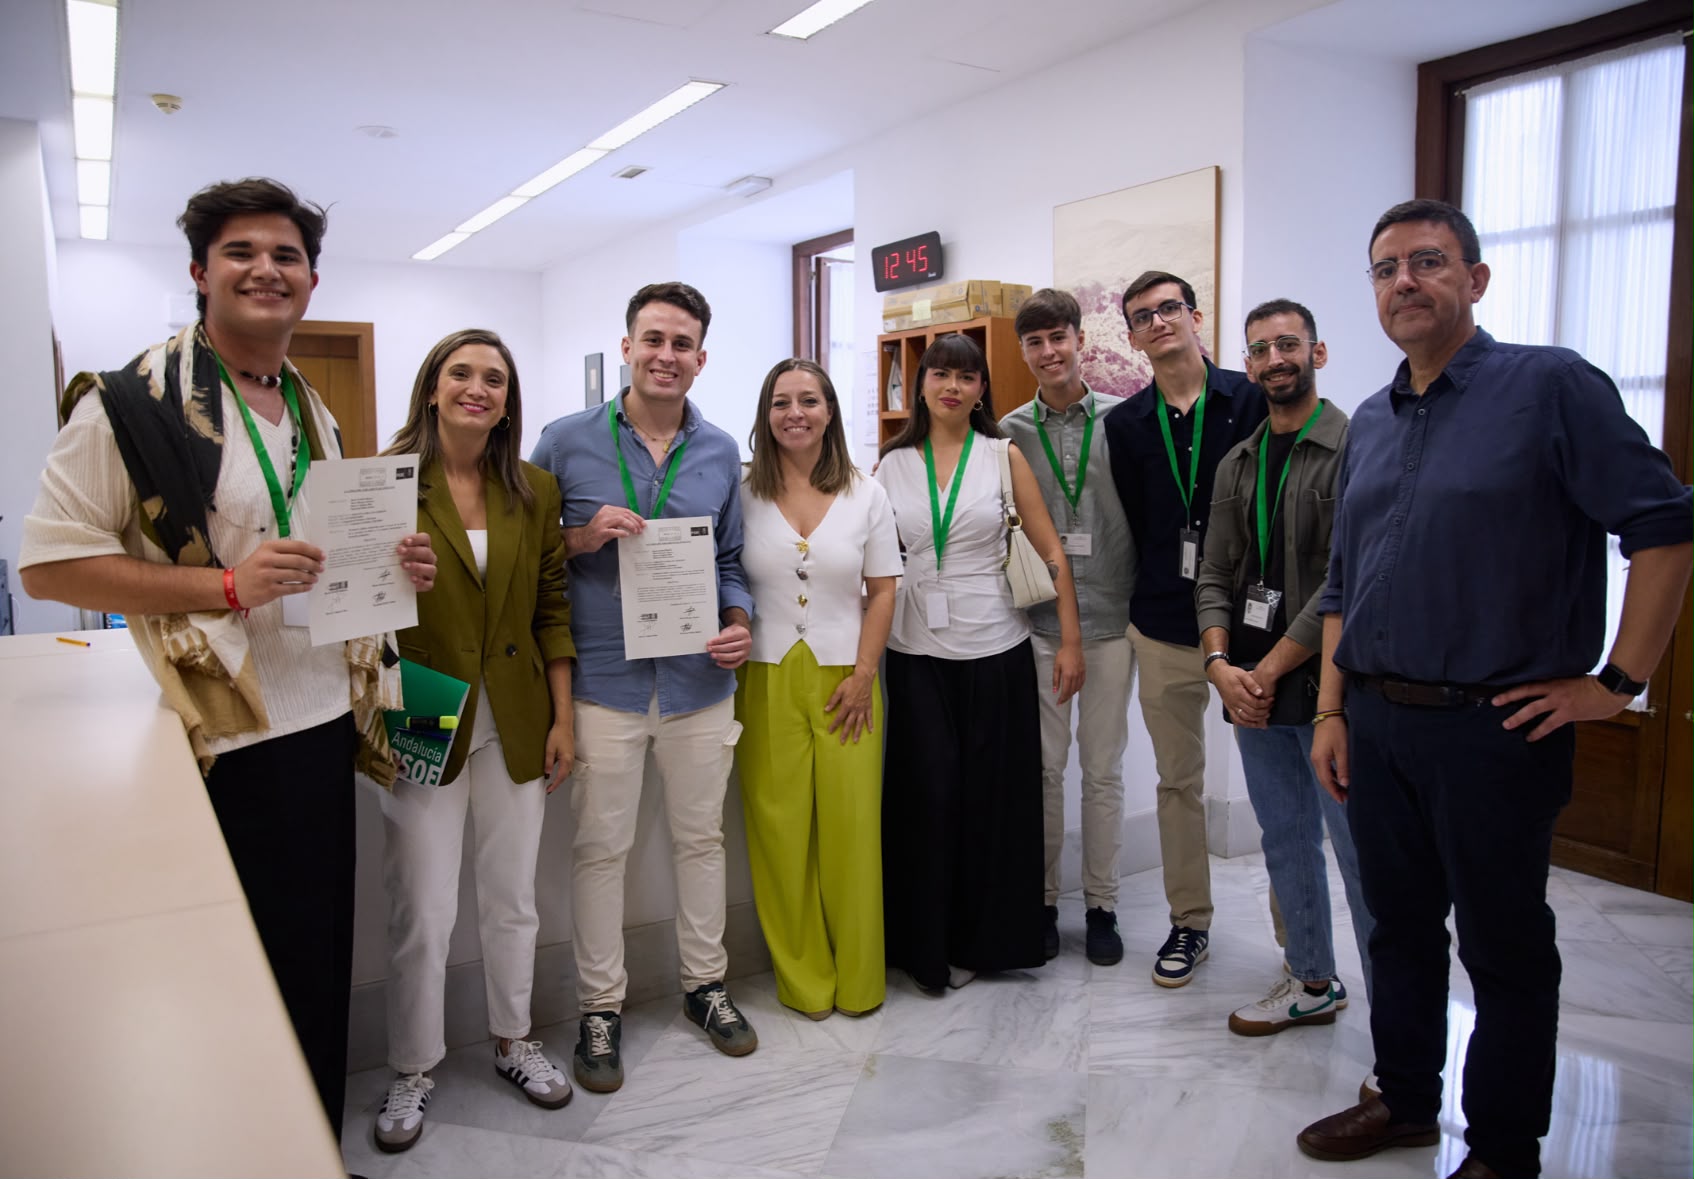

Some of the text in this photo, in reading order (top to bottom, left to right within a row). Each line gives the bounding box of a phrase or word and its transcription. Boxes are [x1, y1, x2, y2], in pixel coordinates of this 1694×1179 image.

[884, 245, 928, 280] 12 45
[391, 731, 442, 763] Andalucía
